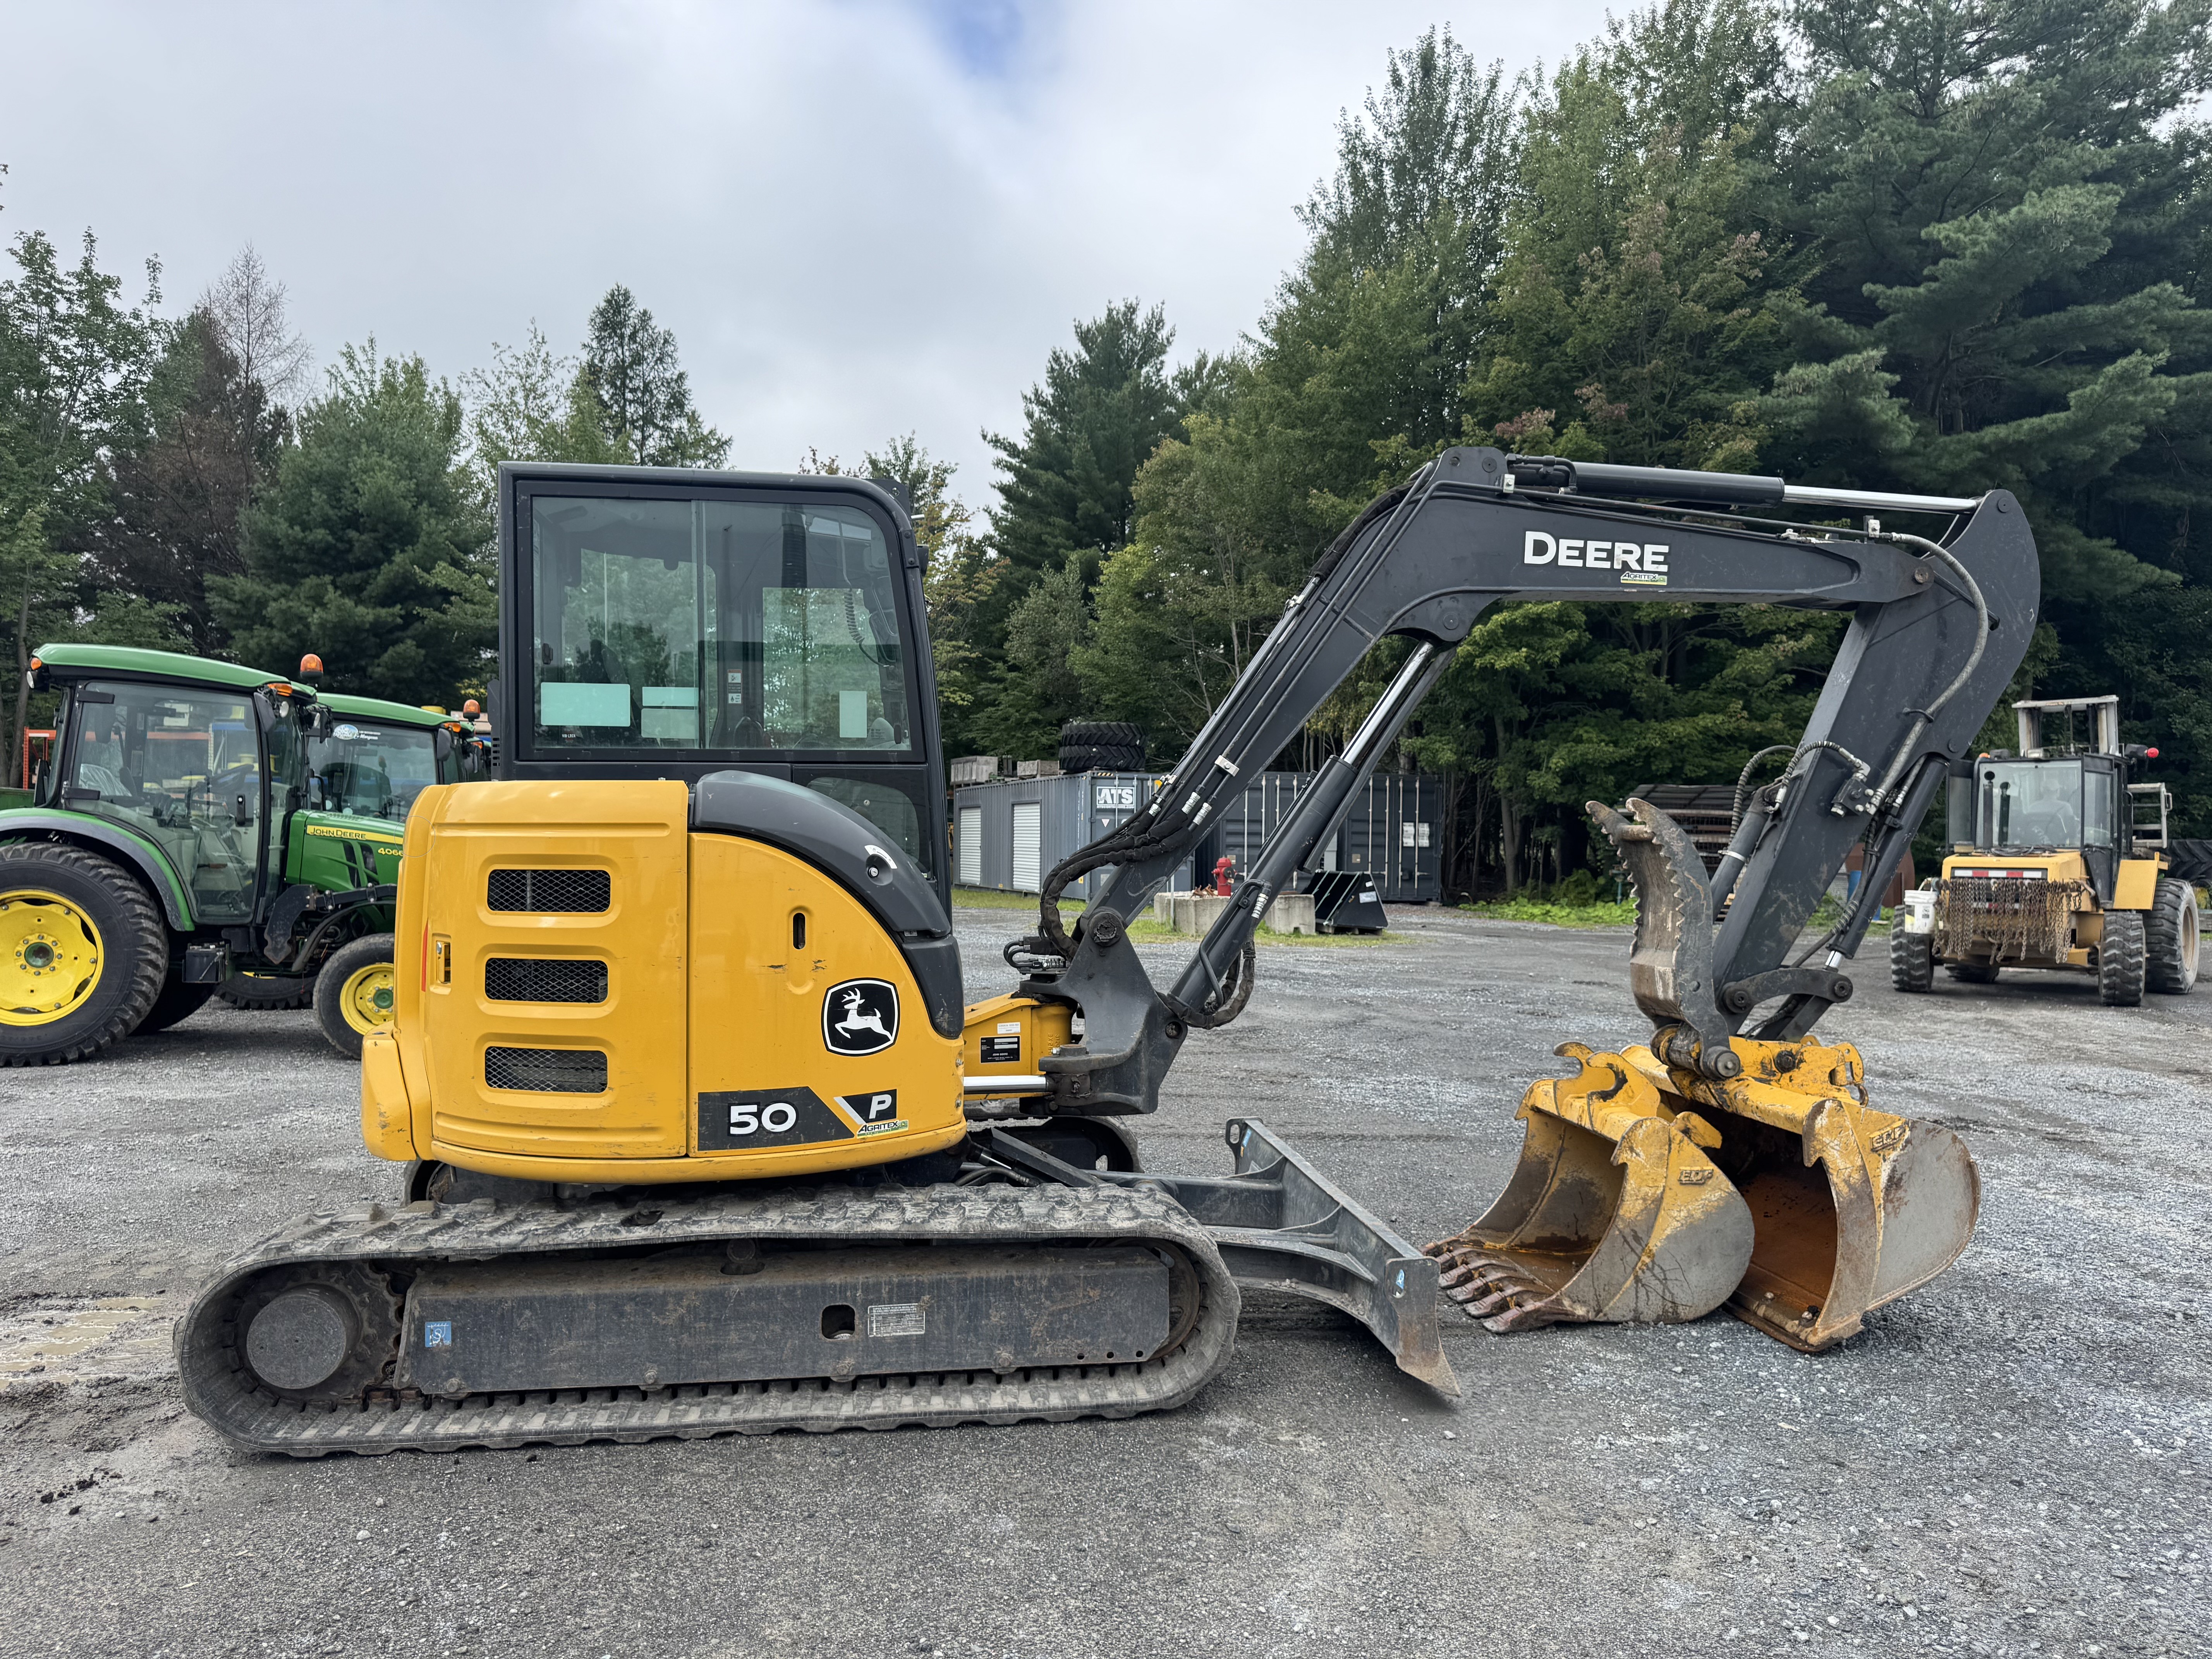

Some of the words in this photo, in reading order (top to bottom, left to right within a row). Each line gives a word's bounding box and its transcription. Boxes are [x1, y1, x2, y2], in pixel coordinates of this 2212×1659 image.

[1524, 531, 1669, 572] DEERE
[1098, 788, 1133, 804] ATS
[311, 827, 334, 836] JOHN
[336, 829, 366, 840] DEERE
[869, 1094, 892, 1119] P
[730, 1103, 797, 1134] 50
[858, 1121, 898, 1133] AGRITEX
